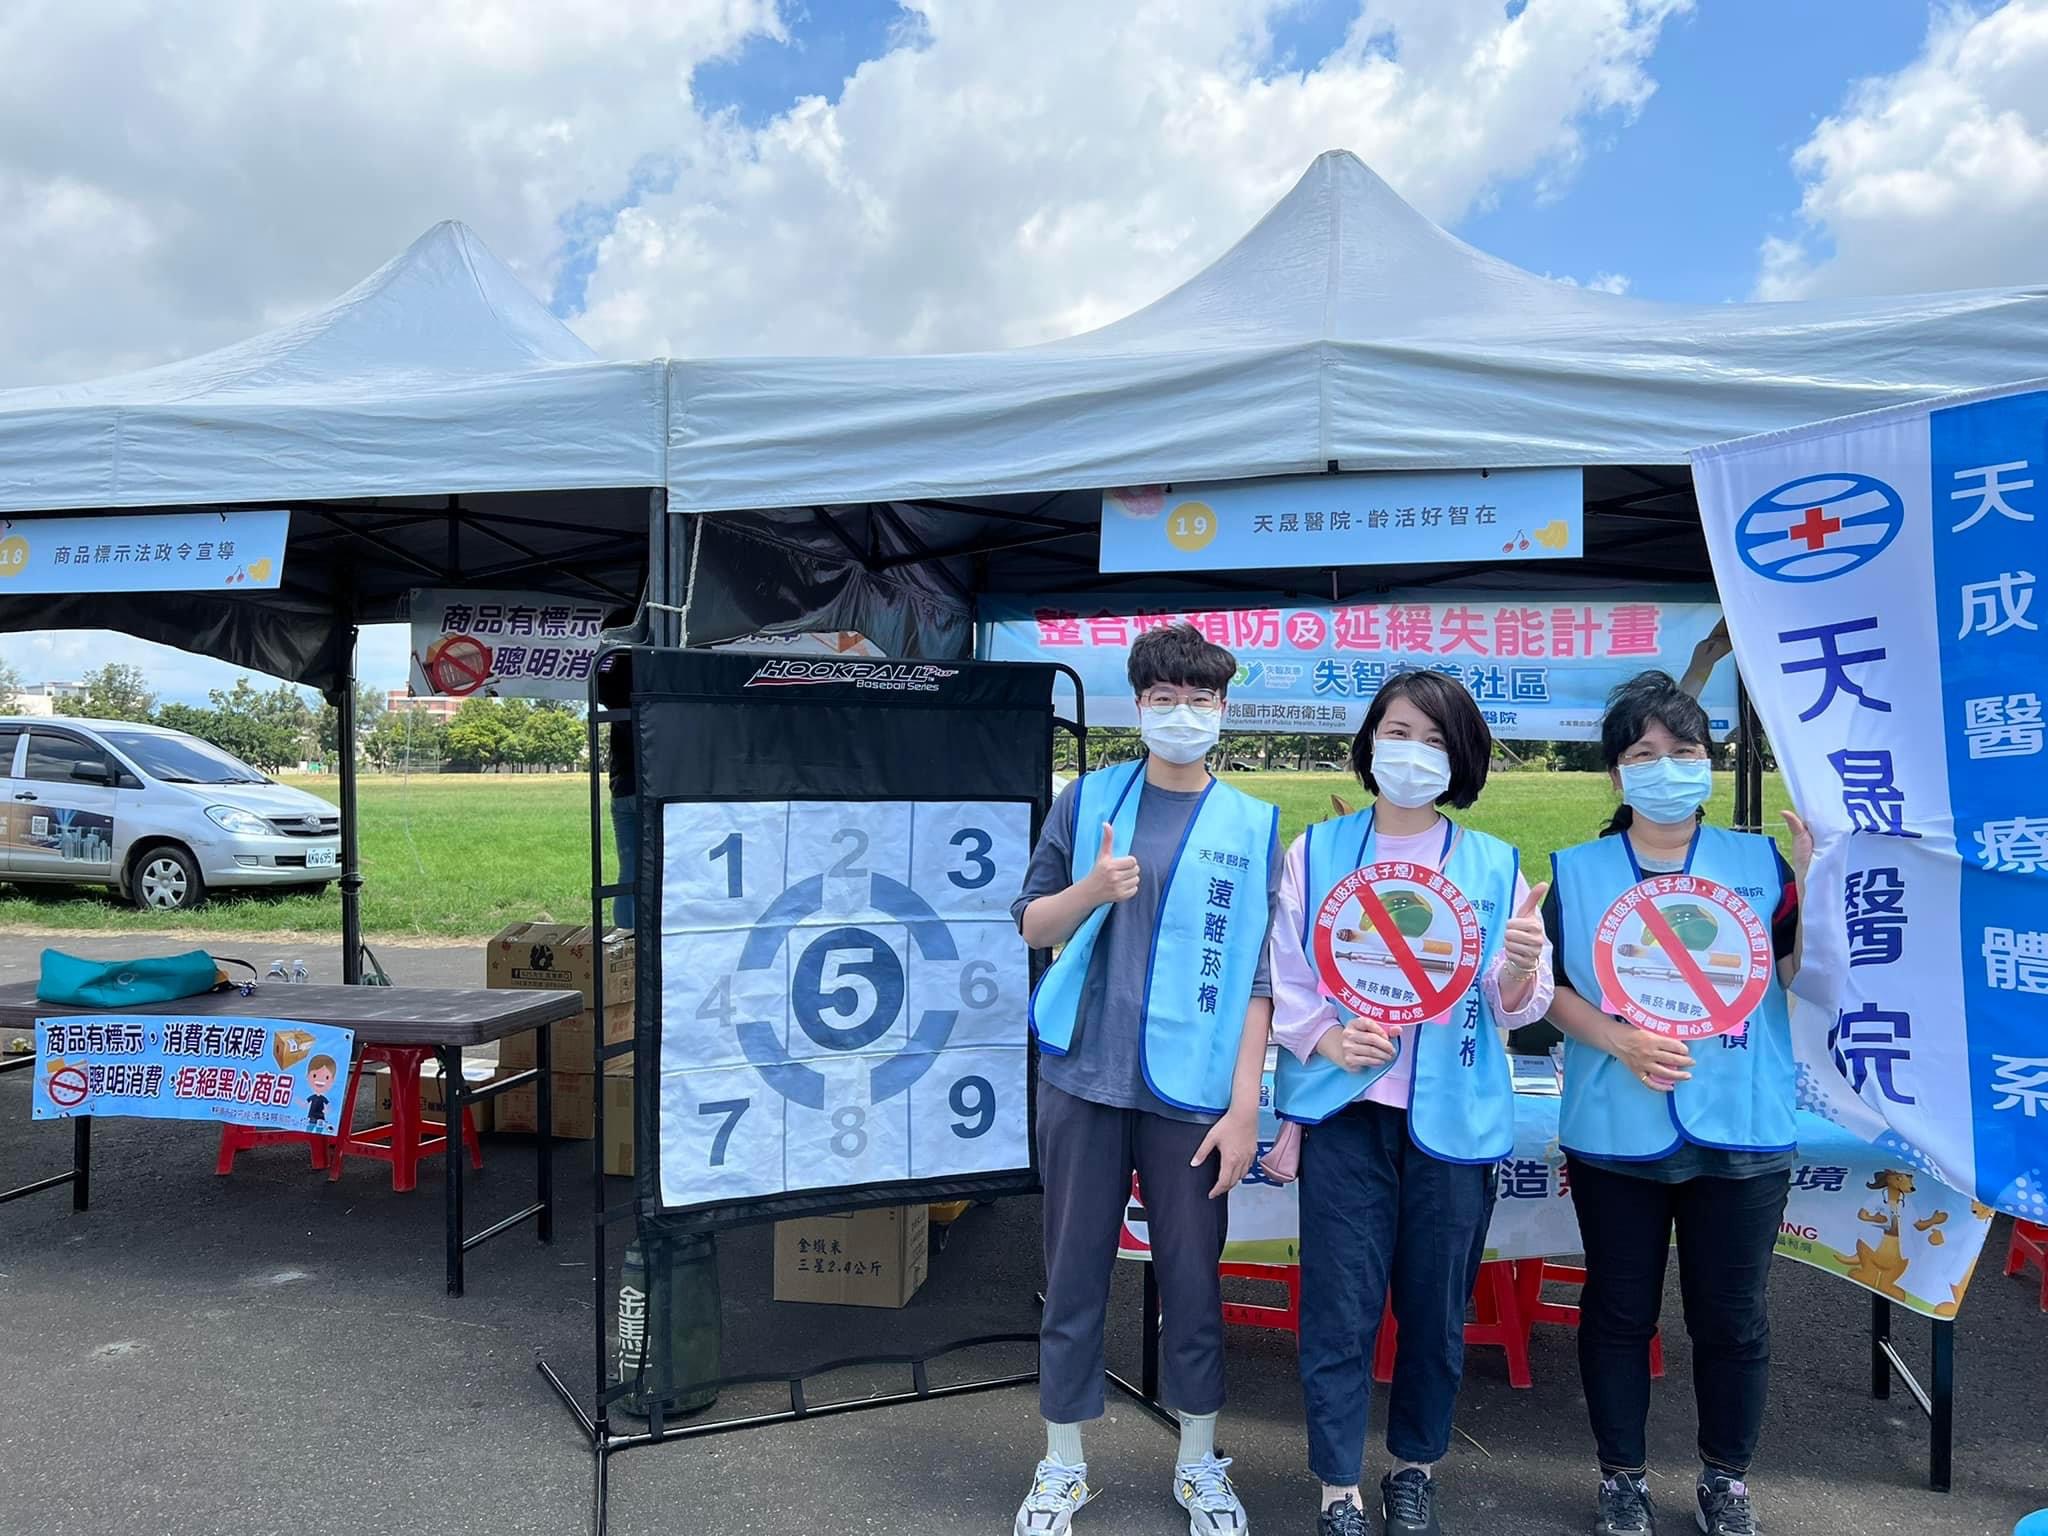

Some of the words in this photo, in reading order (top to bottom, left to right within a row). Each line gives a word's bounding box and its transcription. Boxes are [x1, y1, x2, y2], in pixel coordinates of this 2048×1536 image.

[1175, 516, 1208, 537] 19
[1253, 503, 1498, 535] 天晟醫院-齡活好智在
[0, 547, 23, 565] 18
[54, 541, 236, 565] 商品標示法政令宣導
[440, 604, 602, 637] 商品有標示
[492, 646, 614, 679] 聰明消
[758, 660, 928, 683] HOOKBALL
[856, 680, 906, 691] Baseball
[907, 682, 940, 692] Series
[1228, 703, 1347, 721] 桃園市政府衛生局
[709, 832, 744, 898] 1
[828, 828, 869, 878] 2
[946, 828, 996, 889] 3
[1777, 615, 1923, 1106] 天晟醫院
[1197, 876, 1234, 1015] 遠離菸檳
[818, 948, 878, 1031] 5
[959, 960, 999, 1009] 6
[1355, 978, 1415, 1003] 無菸檳醫院
[696, 975, 737, 1028] 4
[948, 1076, 996, 1139] 9
[699, 1098, 750, 1167] 7
[830, 1106, 868, 1158] 8
[1795, 1166, 1849, 1192] 境
[1779, 1221, 1818, 1240] ING
